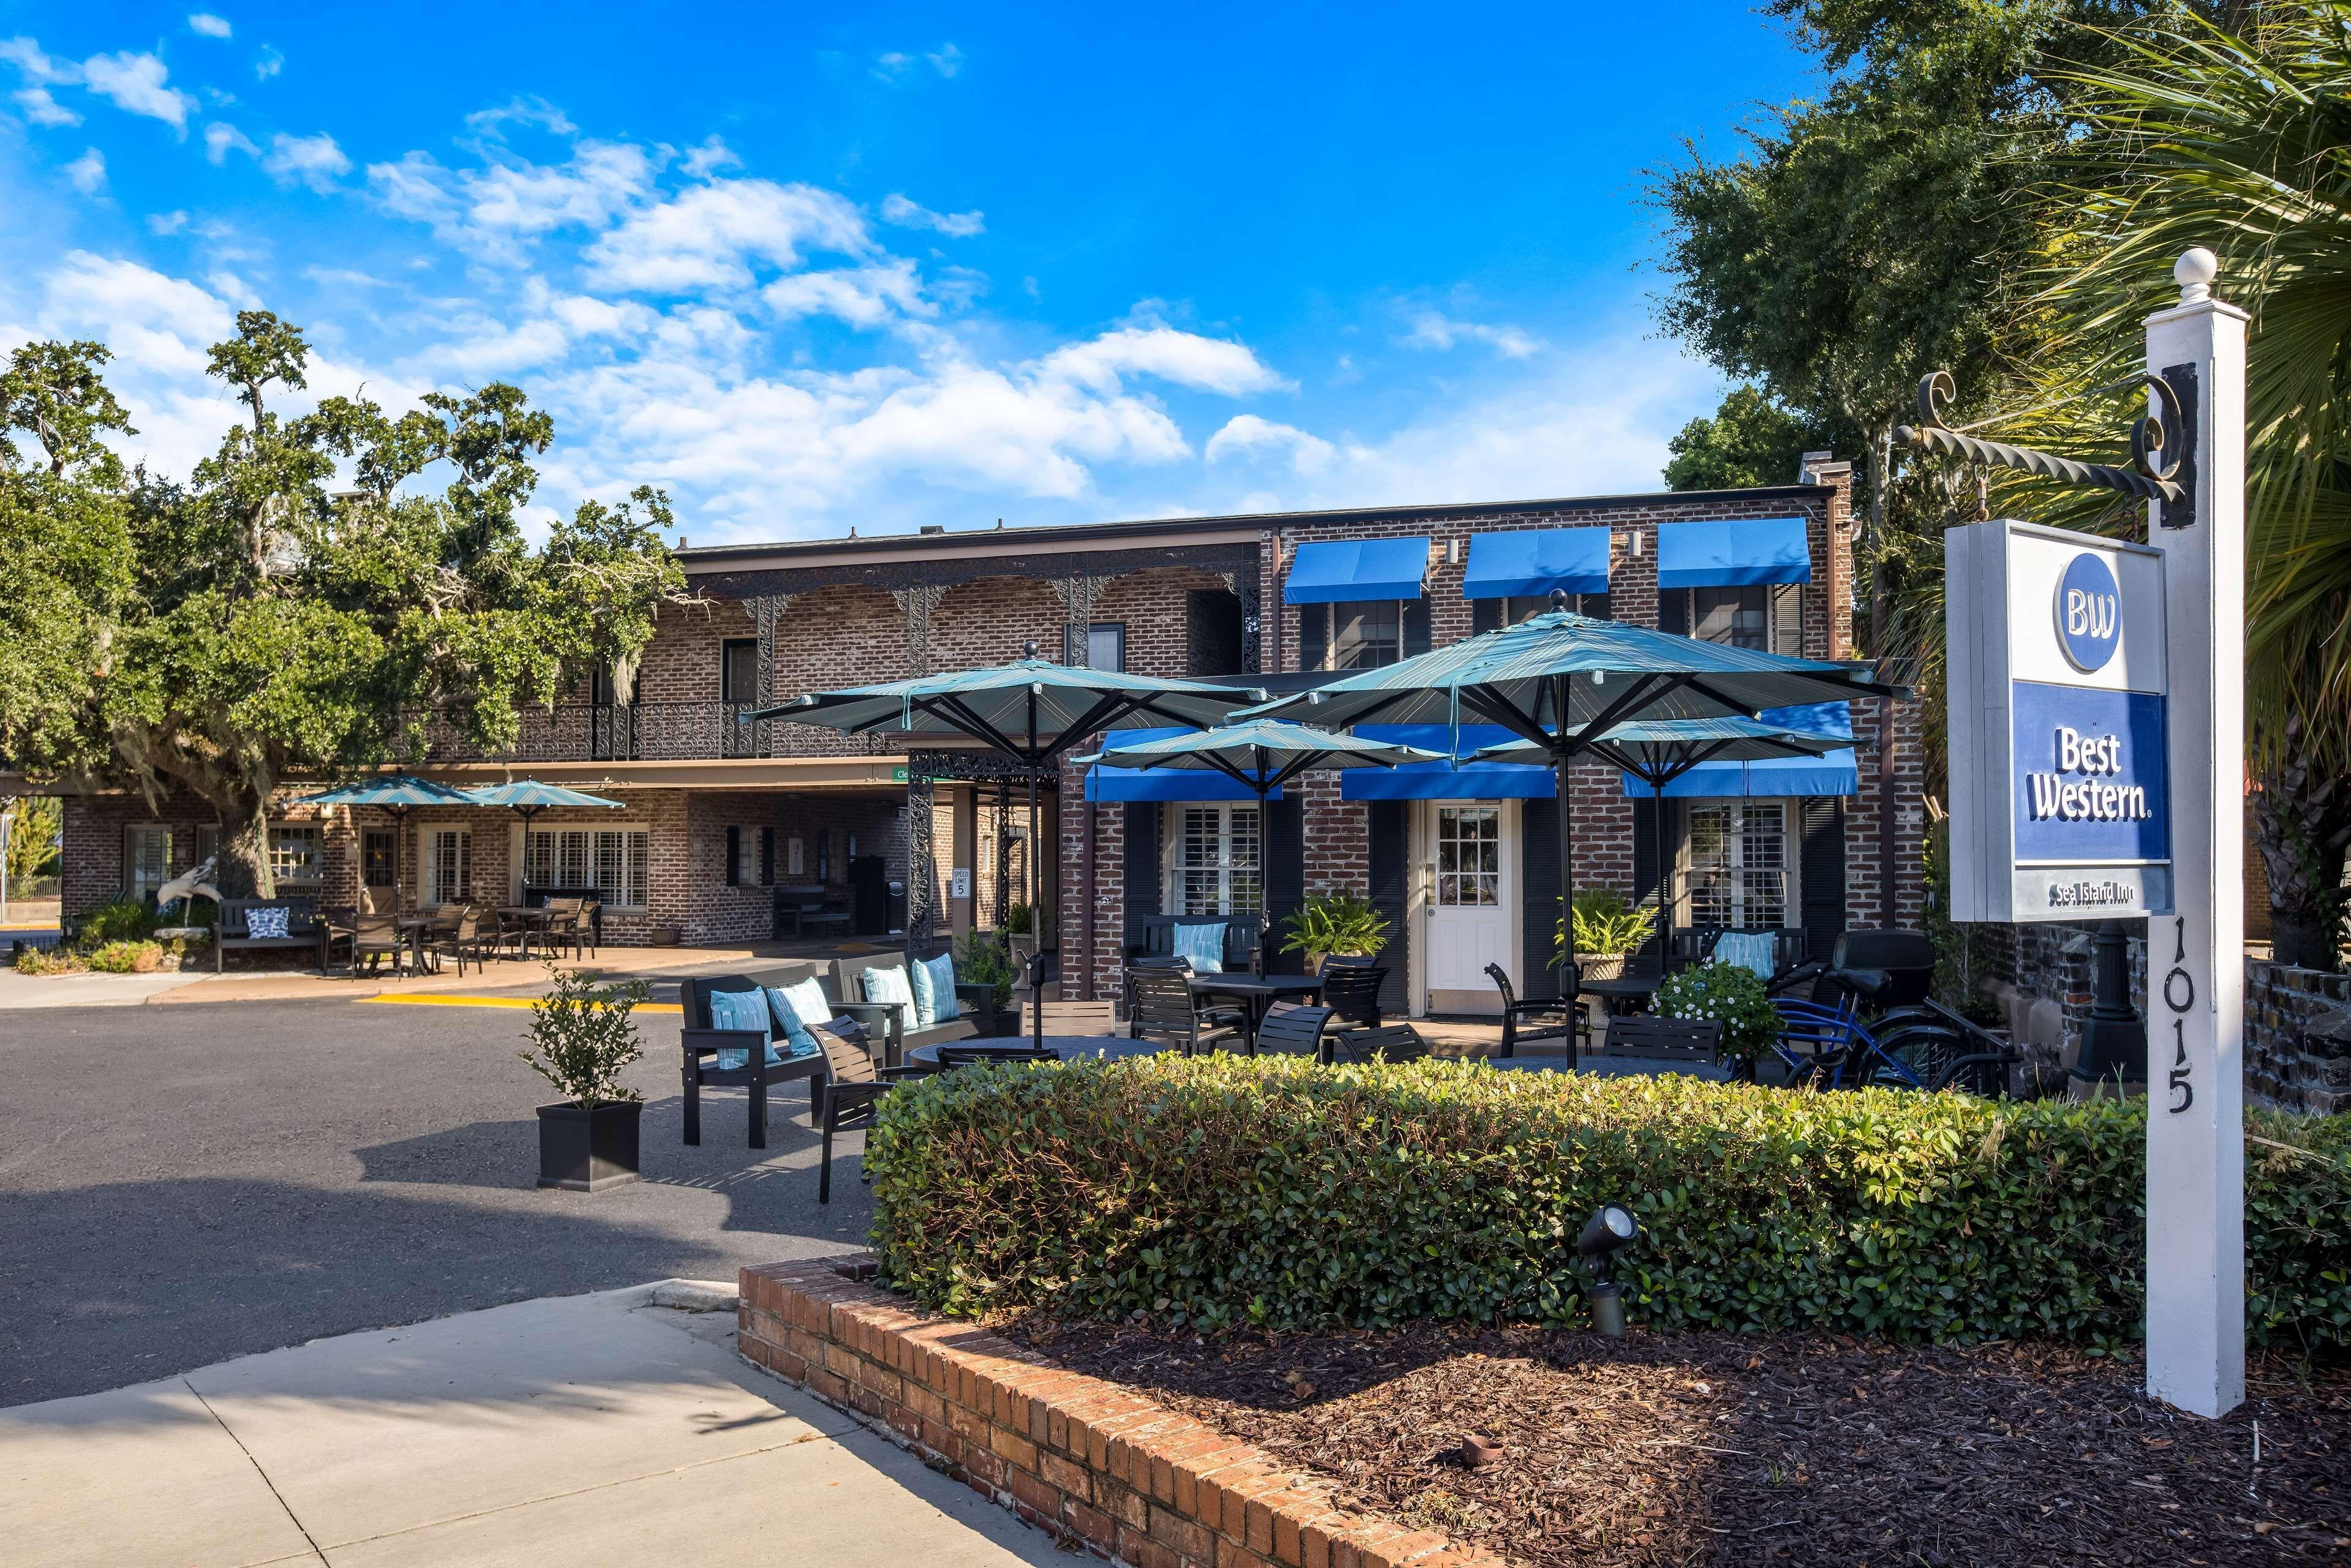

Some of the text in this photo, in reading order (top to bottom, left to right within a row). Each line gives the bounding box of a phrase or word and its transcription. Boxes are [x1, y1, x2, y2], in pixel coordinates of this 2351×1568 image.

[2068, 588, 2116, 639] BW
[2061, 727, 2121, 773] Best
[958, 885, 964, 895] 5
[2056, 882, 2135, 902] Sea Island Inn
[2164, 916, 2195, 1114] 1015
